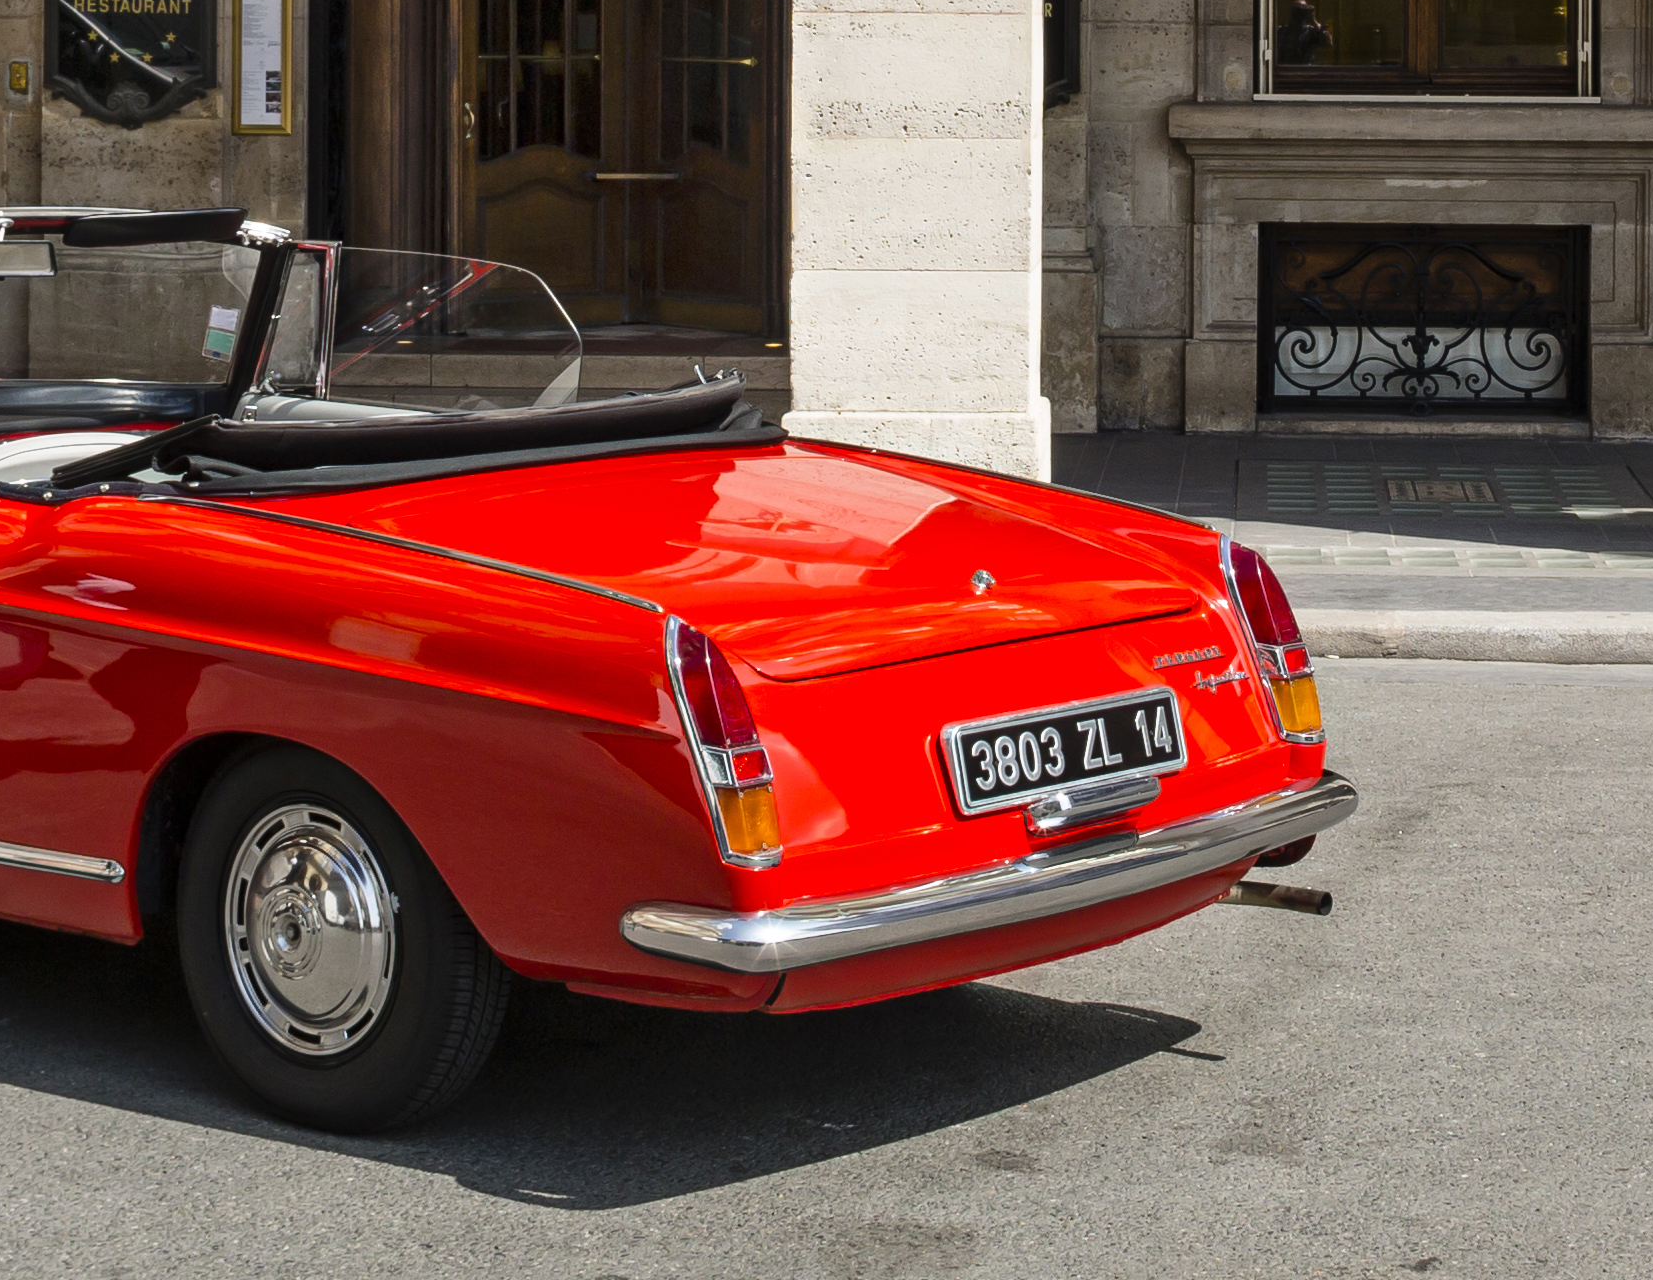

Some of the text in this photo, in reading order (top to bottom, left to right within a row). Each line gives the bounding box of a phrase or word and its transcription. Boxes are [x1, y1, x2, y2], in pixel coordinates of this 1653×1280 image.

[971, 706, 1173, 791] 3803 ZL 14
